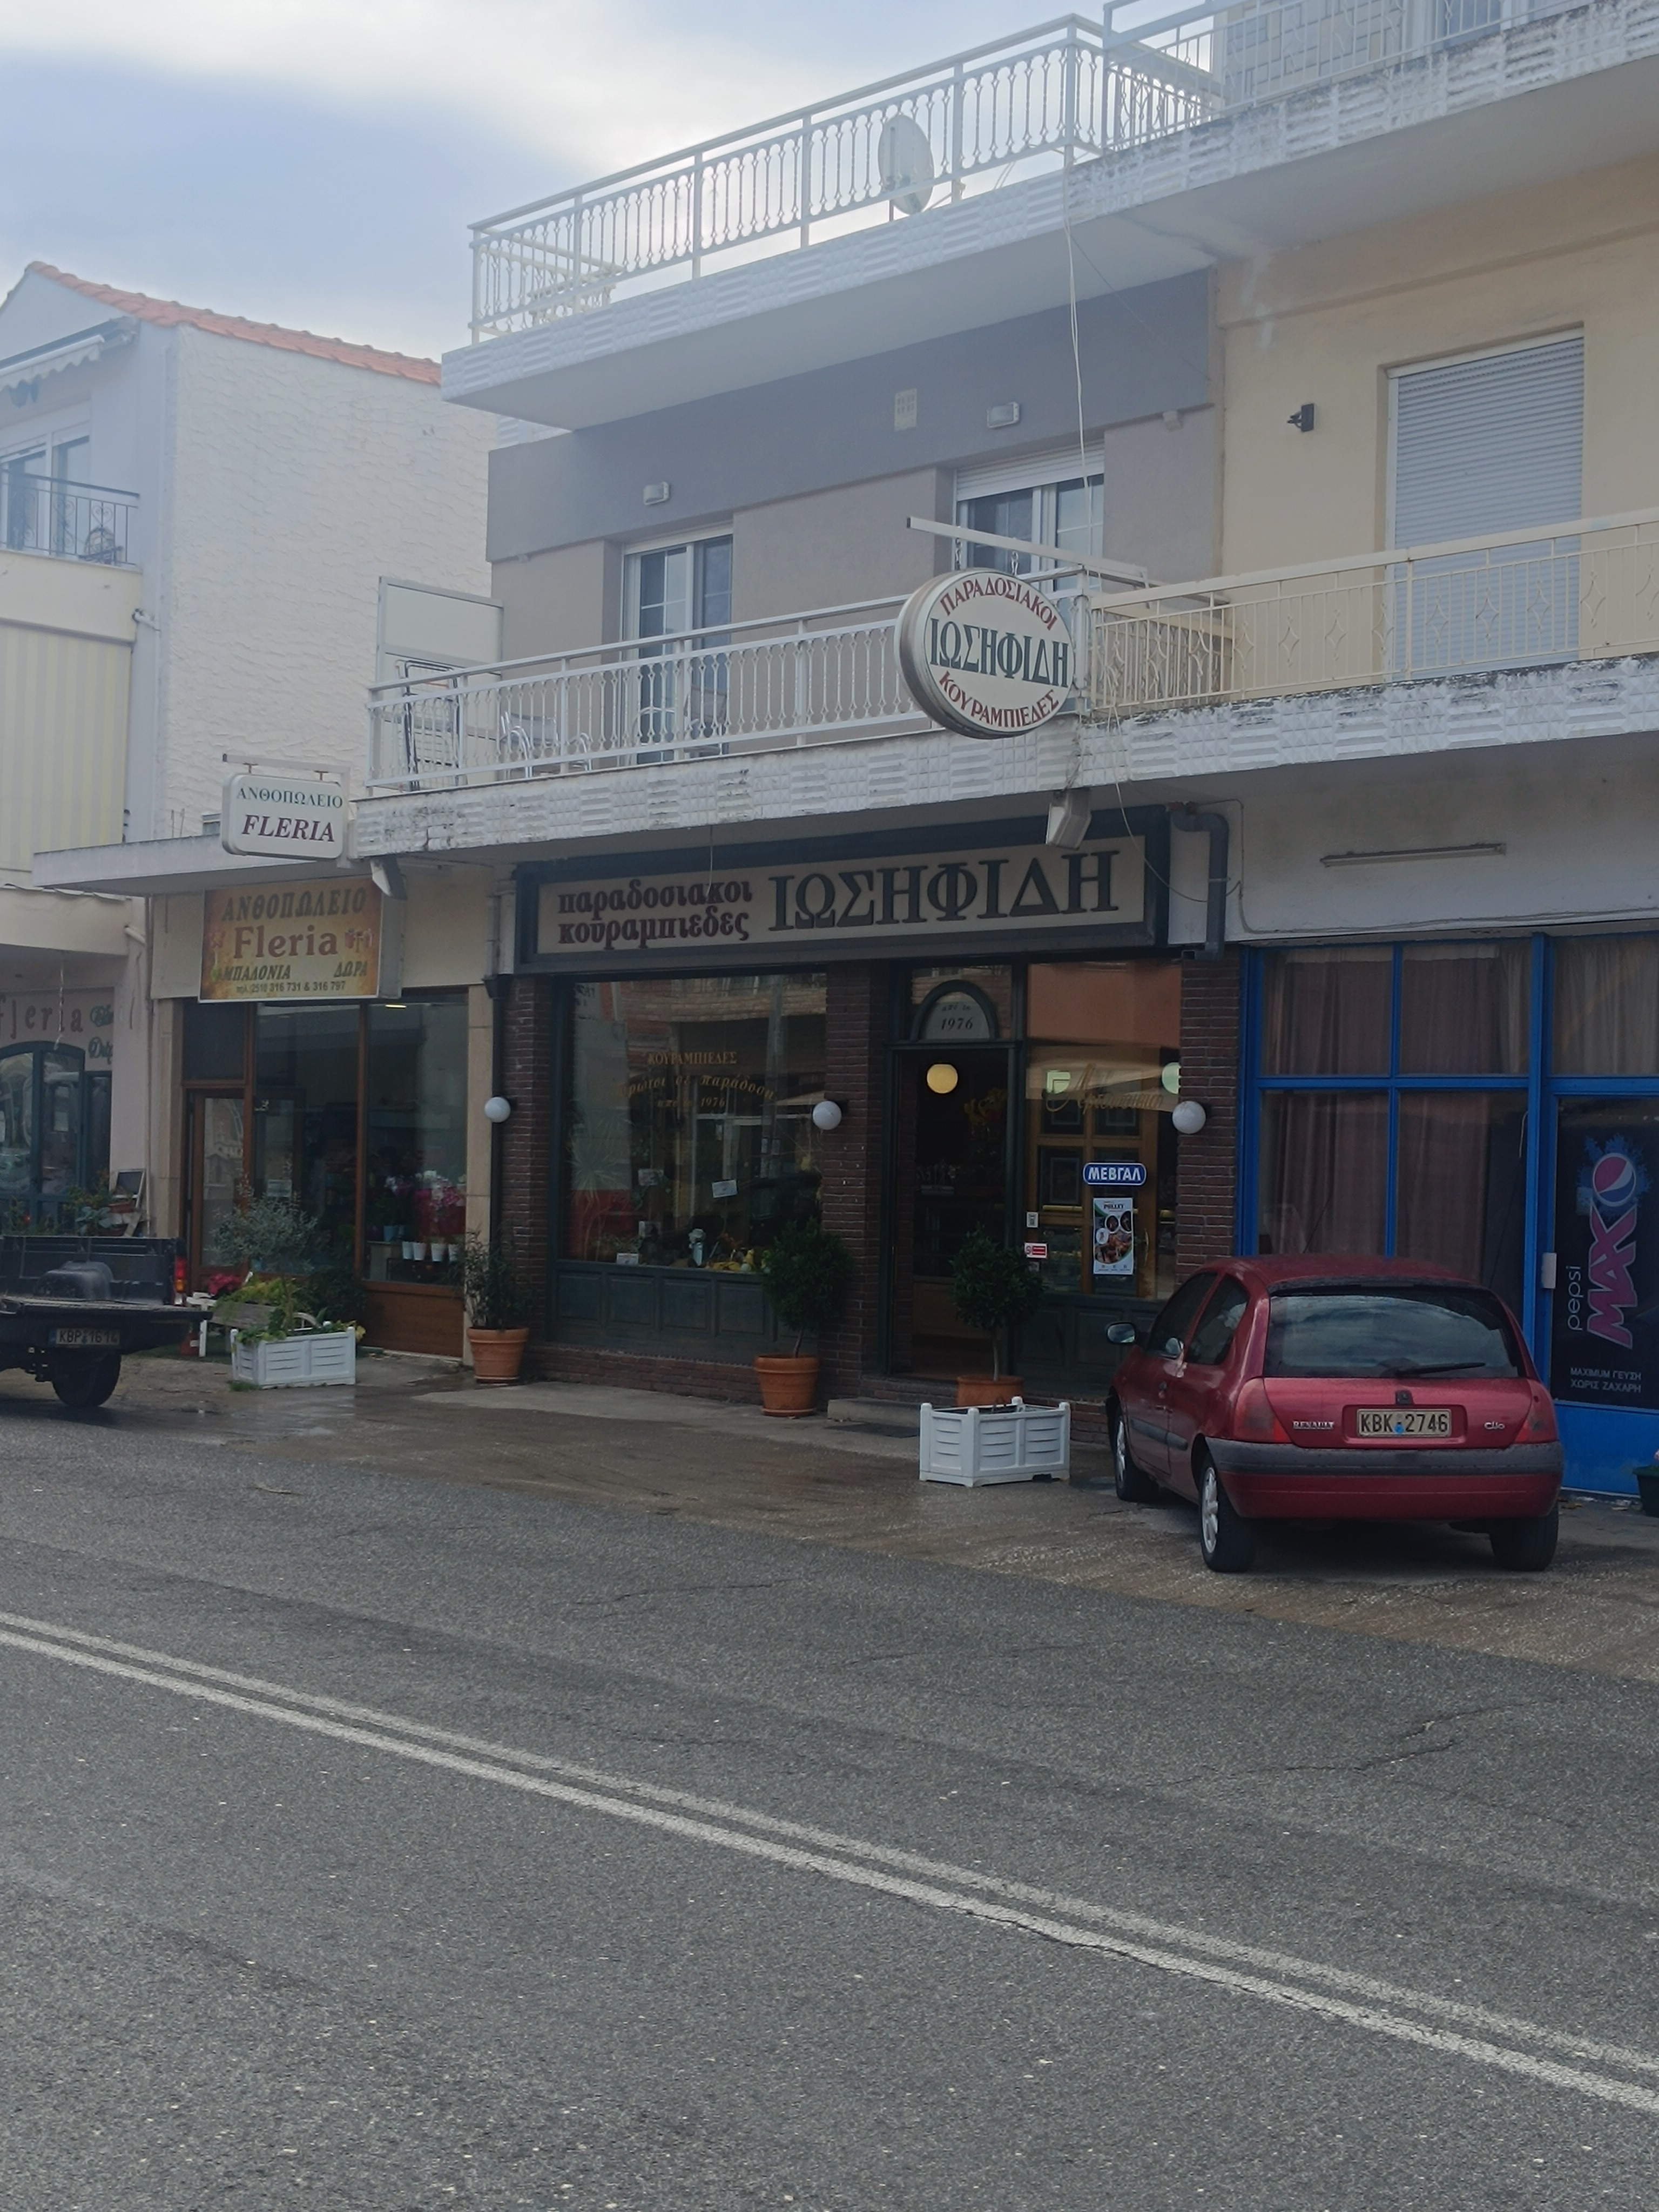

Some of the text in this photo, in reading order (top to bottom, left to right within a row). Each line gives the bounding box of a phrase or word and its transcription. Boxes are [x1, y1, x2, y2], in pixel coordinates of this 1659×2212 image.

[940, 577, 1057, 631] ΠΑΡΑΔΟΣΙΑΚΟΙ
[930, 618, 1069, 688] ΙΩΣΗΦΙΔΗ
[939, 671, 1059, 727] ΚΟΥΡΑΜΠΙΕΔΕΣ
[237, 787, 343, 808] ΑΝΘΟΠΩΛΕΙΟ
[241, 814, 334, 842] FLERIA
[558, 879, 753, 920] παραδοσιακοι
[768, 851, 1120, 931] ΙΩΣΗΦΙΔΗ
[222, 887, 367, 921] ΑΝΘΟΠΩΛΕΙΟ
[558, 905, 750, 950] κουραμπιεδες
[233, 925, 338, 959] Fleria
[221, 961, 368, 981] ΜΠΑΛΟΝΙΑ ΔΩΡΑ
[270, 983, 284, 992] 316
[287, 983, 301, 992] 731
[313, 982, 328, 991] 316
[331, 981, 346, 990] 797
[941, 1017, 973, 1030] 1976
[648, 1051, 737, 1065] ΚΟΥΡΑΜΠΙΕΔΕΣ
[700, 1097, 725, 1108] 1976
[1089, 1167, 1141, 1181] ΜΕΒΓΑΛ
[1587, 1199, 1638, 1350] MAX
[1566, 1265, 1583, 1331] pepsi
[1570, 1367, 1642, 1381] MAXIMUM ΓΕΥΣΗ
[1570, 1379, 1642, 1394] ΧΩΡΙΣ ΖΑΧΑΡΗ
[1293, 1421, 1334, 1430] RENAULT
[1484, 1421, 1506, 1430] Clio
